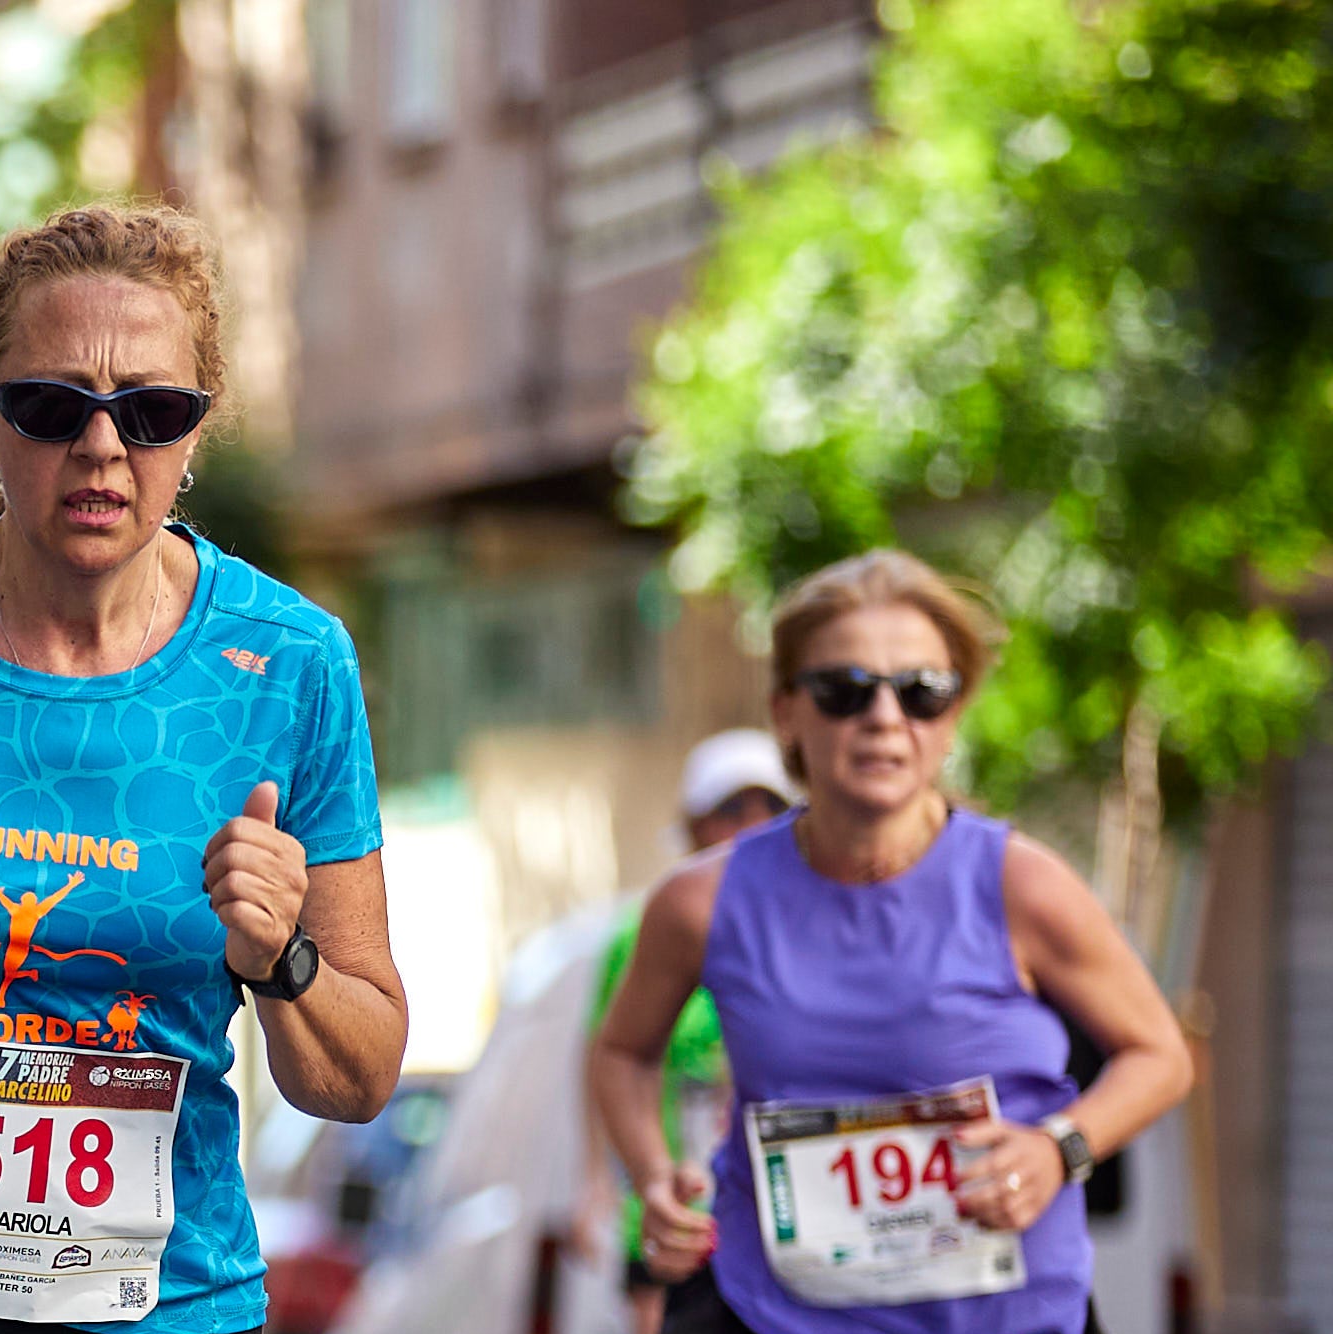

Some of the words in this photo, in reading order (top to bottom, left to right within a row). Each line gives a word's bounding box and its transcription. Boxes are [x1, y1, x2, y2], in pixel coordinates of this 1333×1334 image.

[221, 647, 271, 670] 42K
[18, 1051, 76, 1067] MEMORIAL
[17, 1064, 70, 1084] PADRE
[109, 1080, 142, 1089] NIPPON
[143, 1081, 171, 1091] GASES
[829, 1137, 958, 1209] 194
[101, 1247, 148, 1260] ANAYA
[27, 1275, 56, 1284] GARCIA
[21, 1285, 33, 1294] 50
